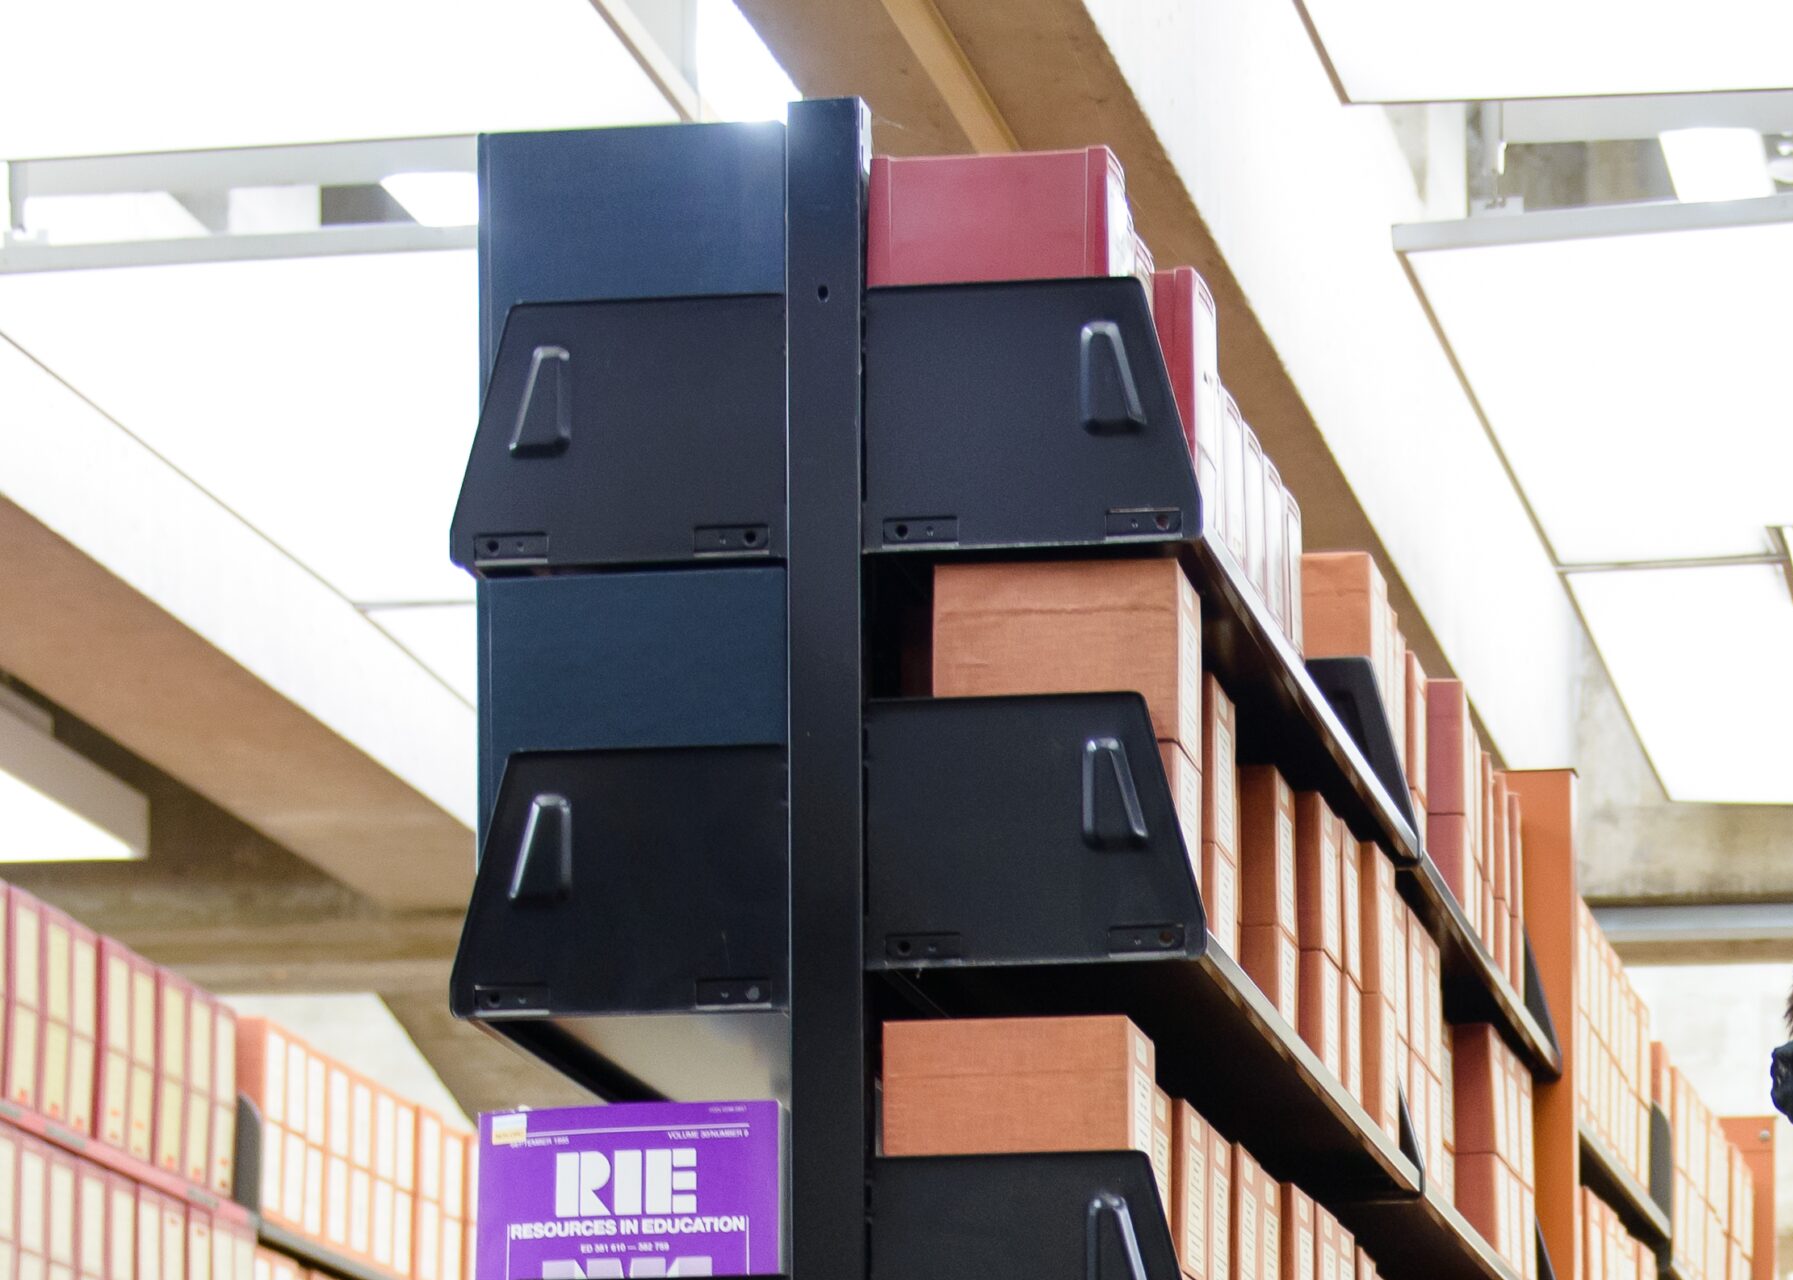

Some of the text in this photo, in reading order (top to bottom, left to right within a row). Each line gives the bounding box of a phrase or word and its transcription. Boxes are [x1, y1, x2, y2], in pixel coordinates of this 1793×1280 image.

[555, 1148, 697, 1217] RIE
[511, 1216, 746, 1240] RESOURCES IN EDUCATION
